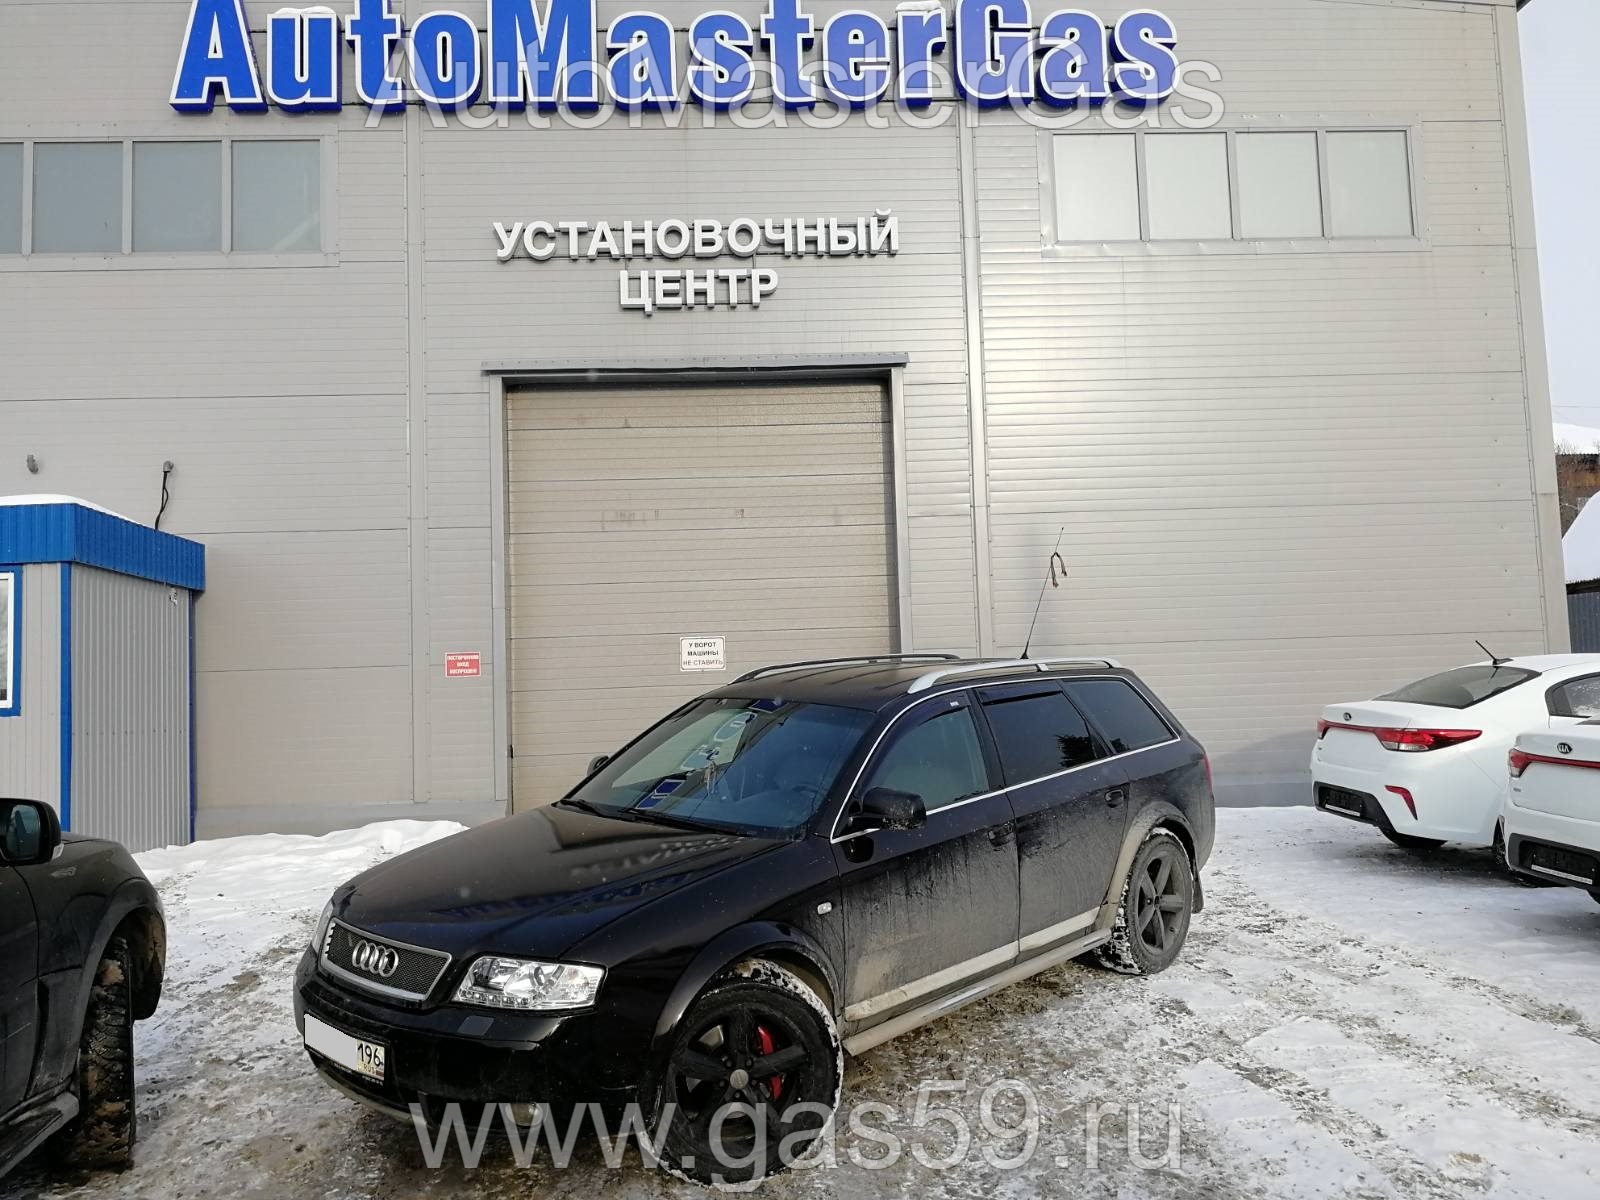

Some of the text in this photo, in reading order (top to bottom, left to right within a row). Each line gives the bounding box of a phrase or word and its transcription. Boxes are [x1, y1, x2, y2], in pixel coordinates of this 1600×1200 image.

[168, 0, 1181, 113] AutoMasterGas
[493, 208, 900, 261] УСТАНОВОЧНЫЙ
[618, 267, 779, 317] ЦЕНТР
[357, 1043, 381, 1067] 196
